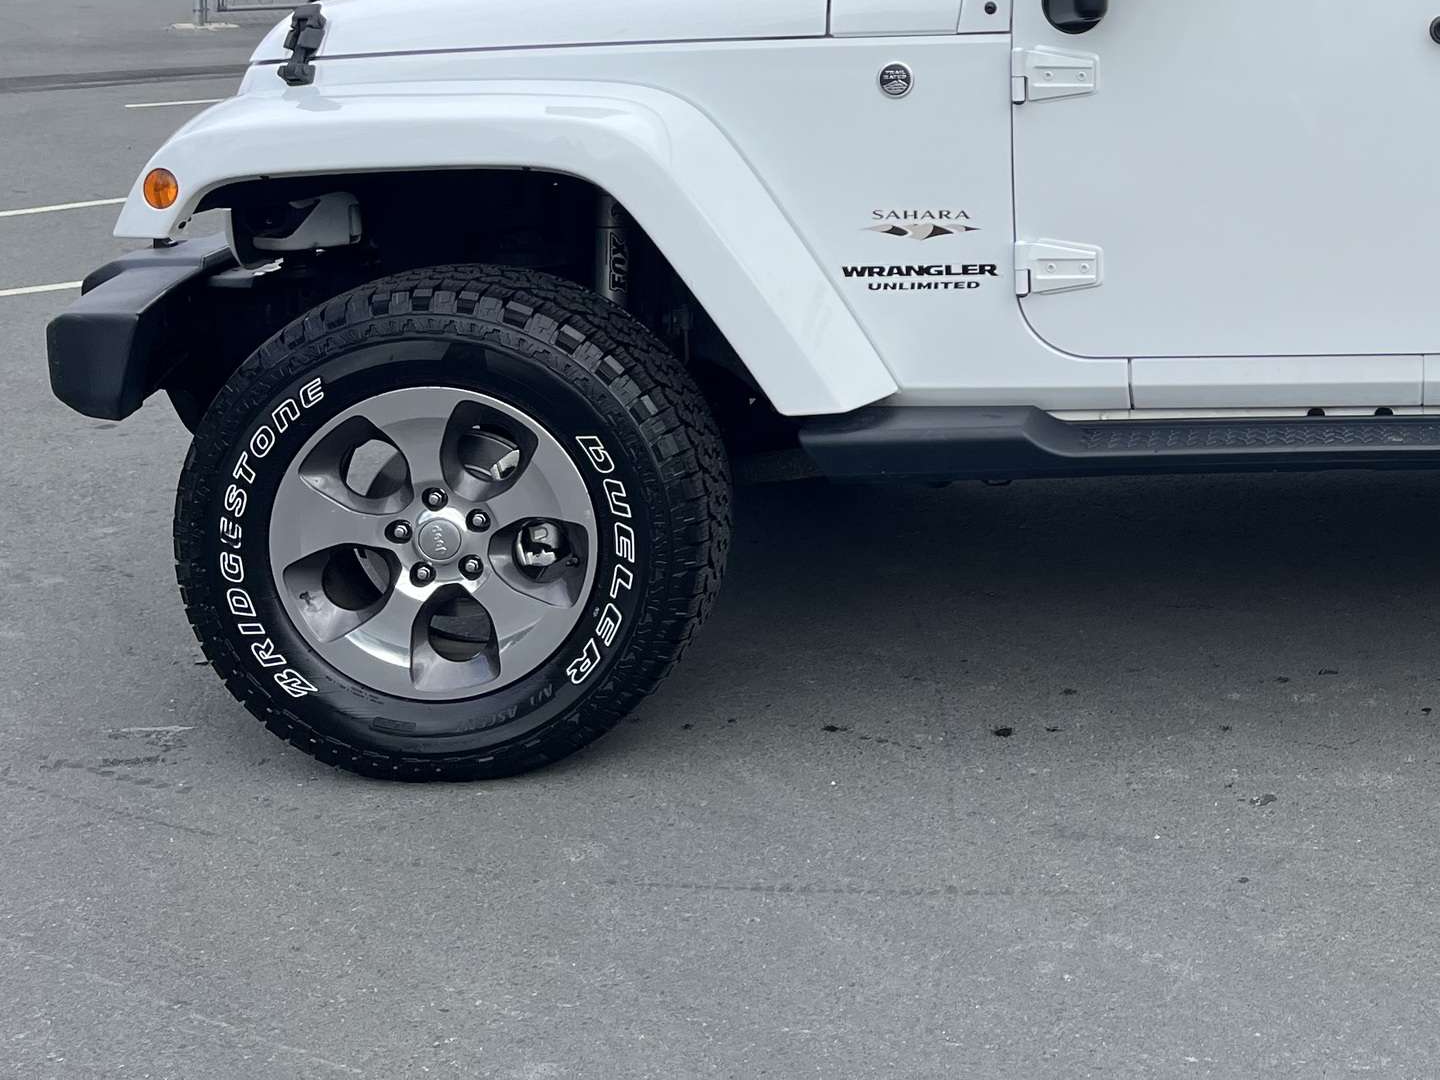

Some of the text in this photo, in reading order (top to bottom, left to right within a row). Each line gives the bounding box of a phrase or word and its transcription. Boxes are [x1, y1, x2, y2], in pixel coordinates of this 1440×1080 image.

[872, 209, 971, 220] SAHARA
[842, 263, 999, 277] WRANGLER
[868, 281, 980, 291] UNLIMITED
[220, 378, 324, 699] BRIDGESTONE
[566, 435, 636, 686] DUELER
